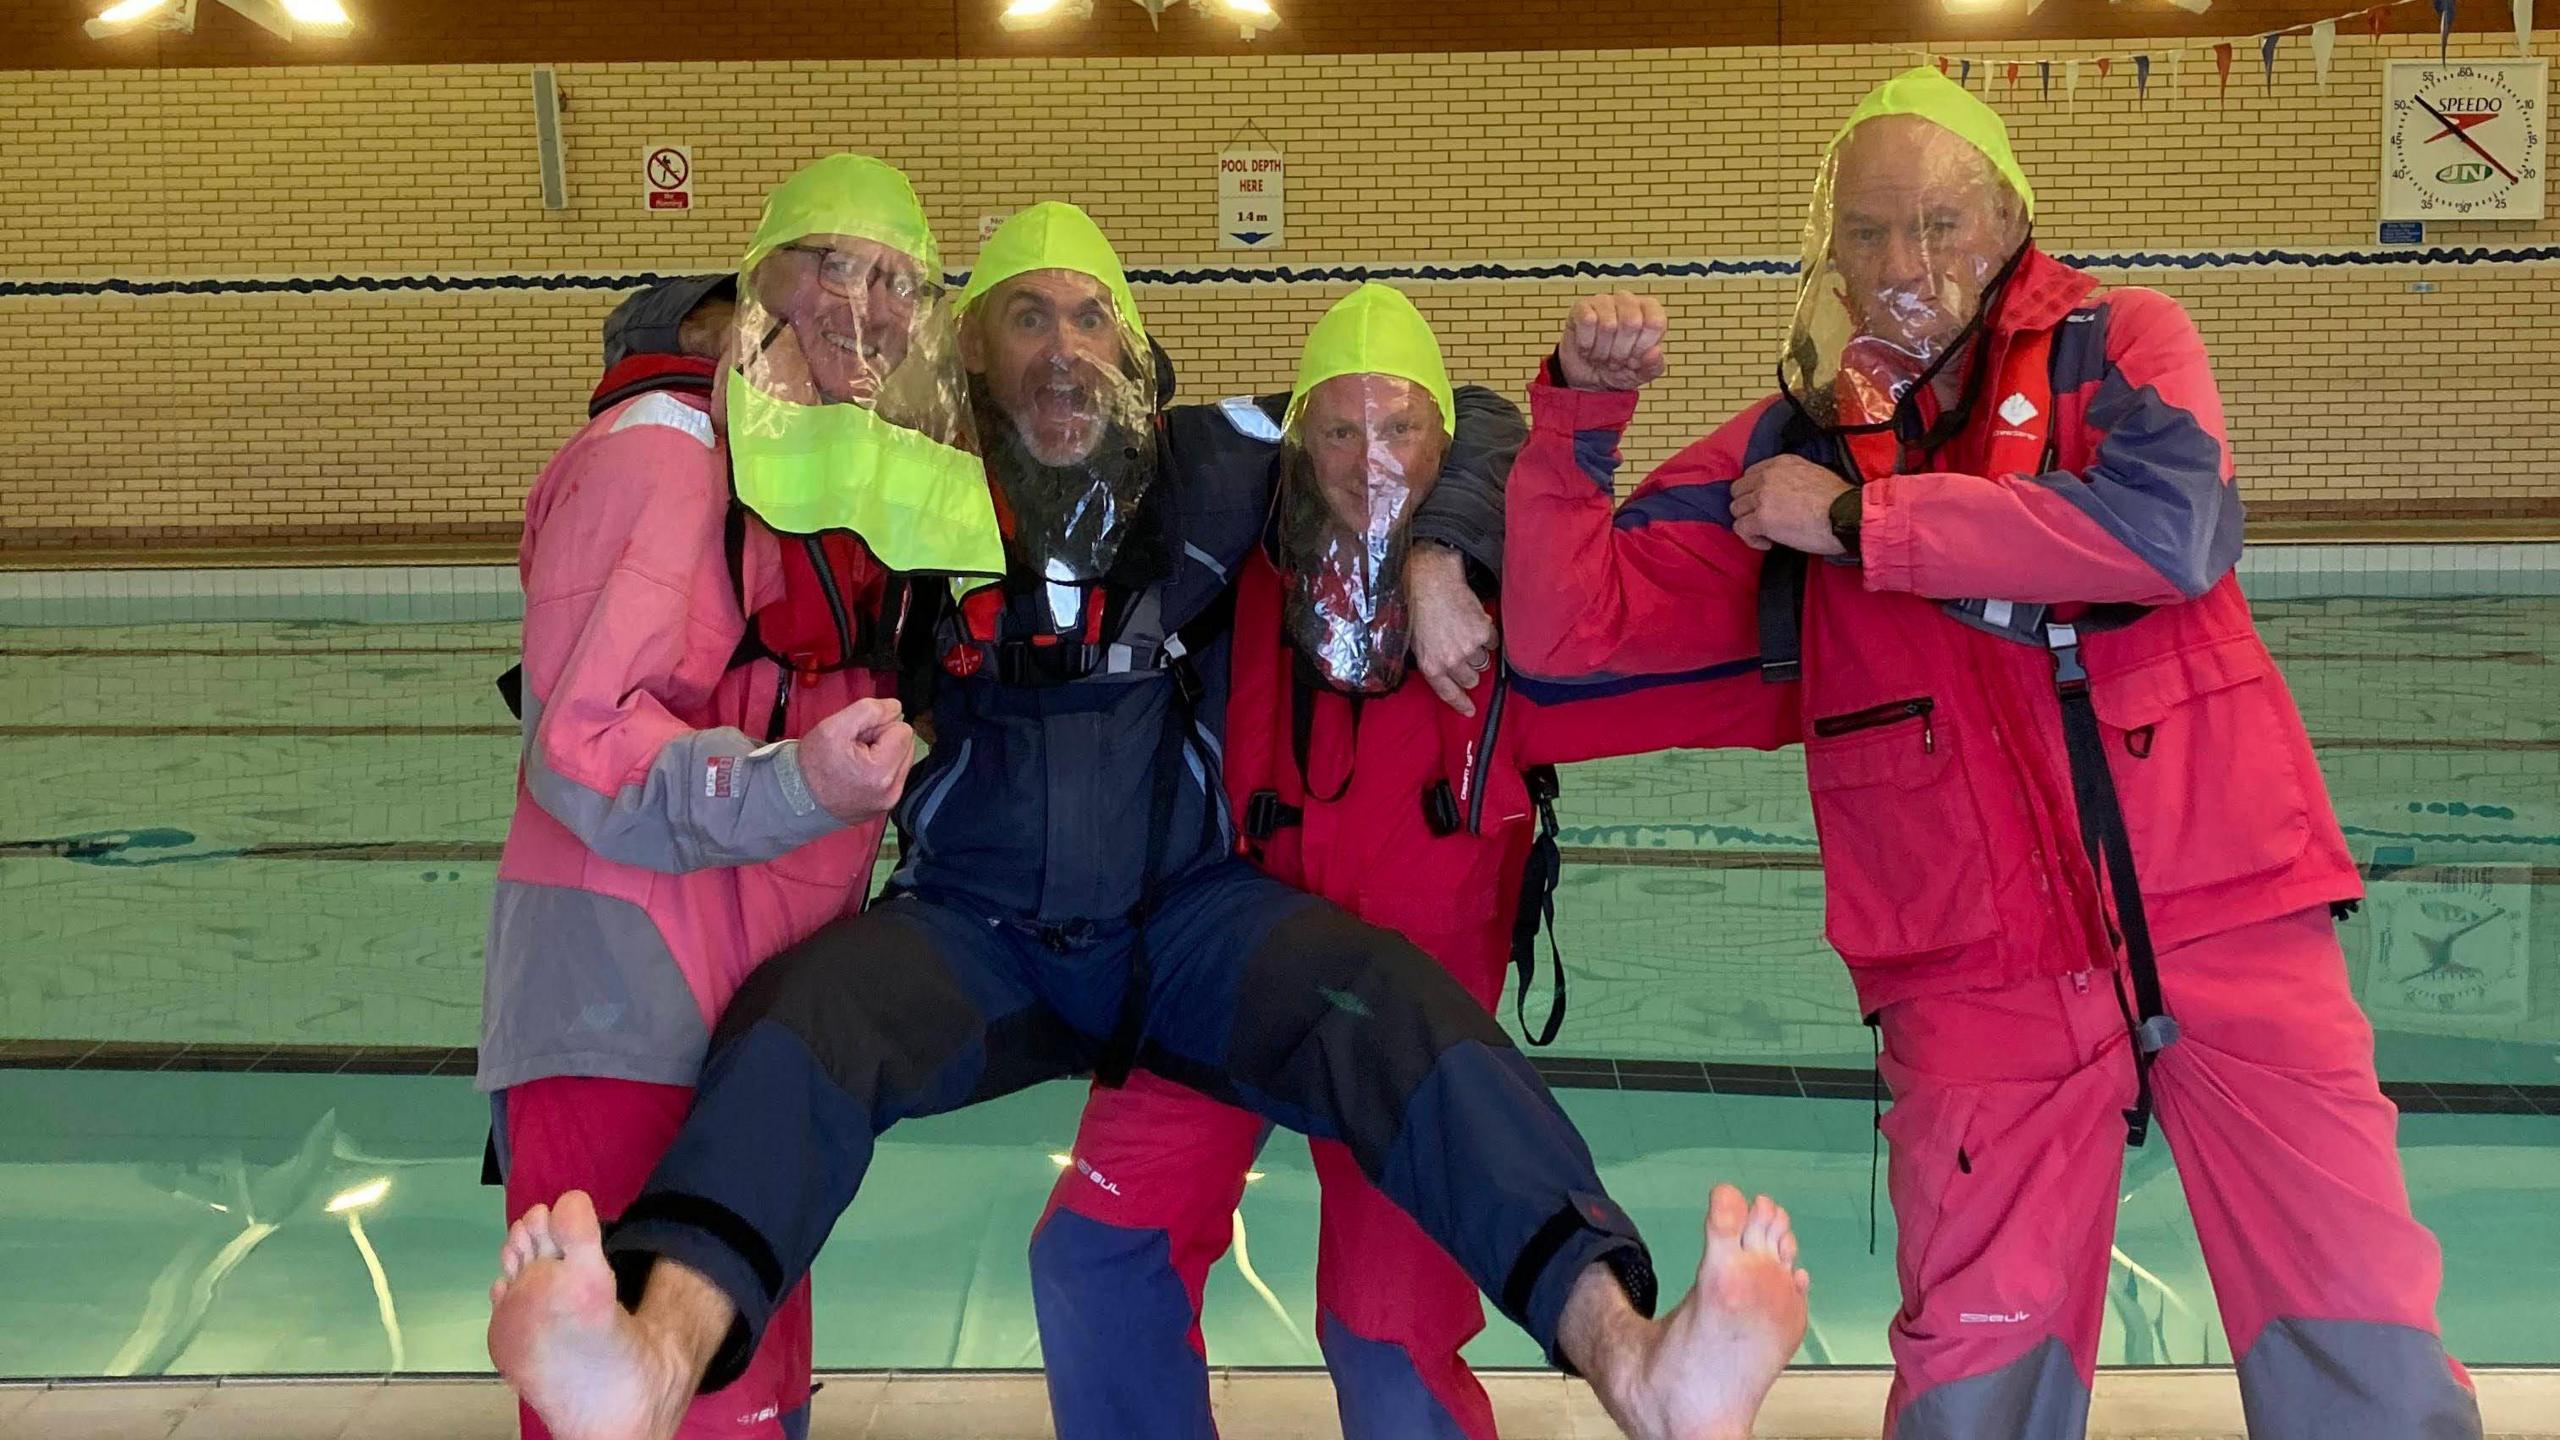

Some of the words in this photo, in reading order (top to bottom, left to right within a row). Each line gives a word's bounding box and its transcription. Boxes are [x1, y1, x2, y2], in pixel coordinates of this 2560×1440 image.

[2422, 71, 2434, 82] 55
[2459, 67, 2472, 77] 60
[2498, 71, 2504, 81] 5
[2394, 100, 2406, 110] 50
[2438, 97, 2502, 112] SPEEDO
[2525, 100, 2534, 109] 10
[2390, 135, 2401, 145] 45
[2528, 134, 2538, 145] 15
[1221, 159, 1248, 172] POOL
[1251, 159, 1281, 172] DEPTH
[2392, 169, 2405, 179] 40
[2439, 164, 2487, 181] JN
[2523, 168, 2536, 179] 20
[1239, 179, 1263, 192] HERE
[2421, 199, 2433, 210] 35
[2457, 203, 2469, 213] 30
[2494, 198, 2507, 209] 25
[1256, 214, 1268, 222] m
